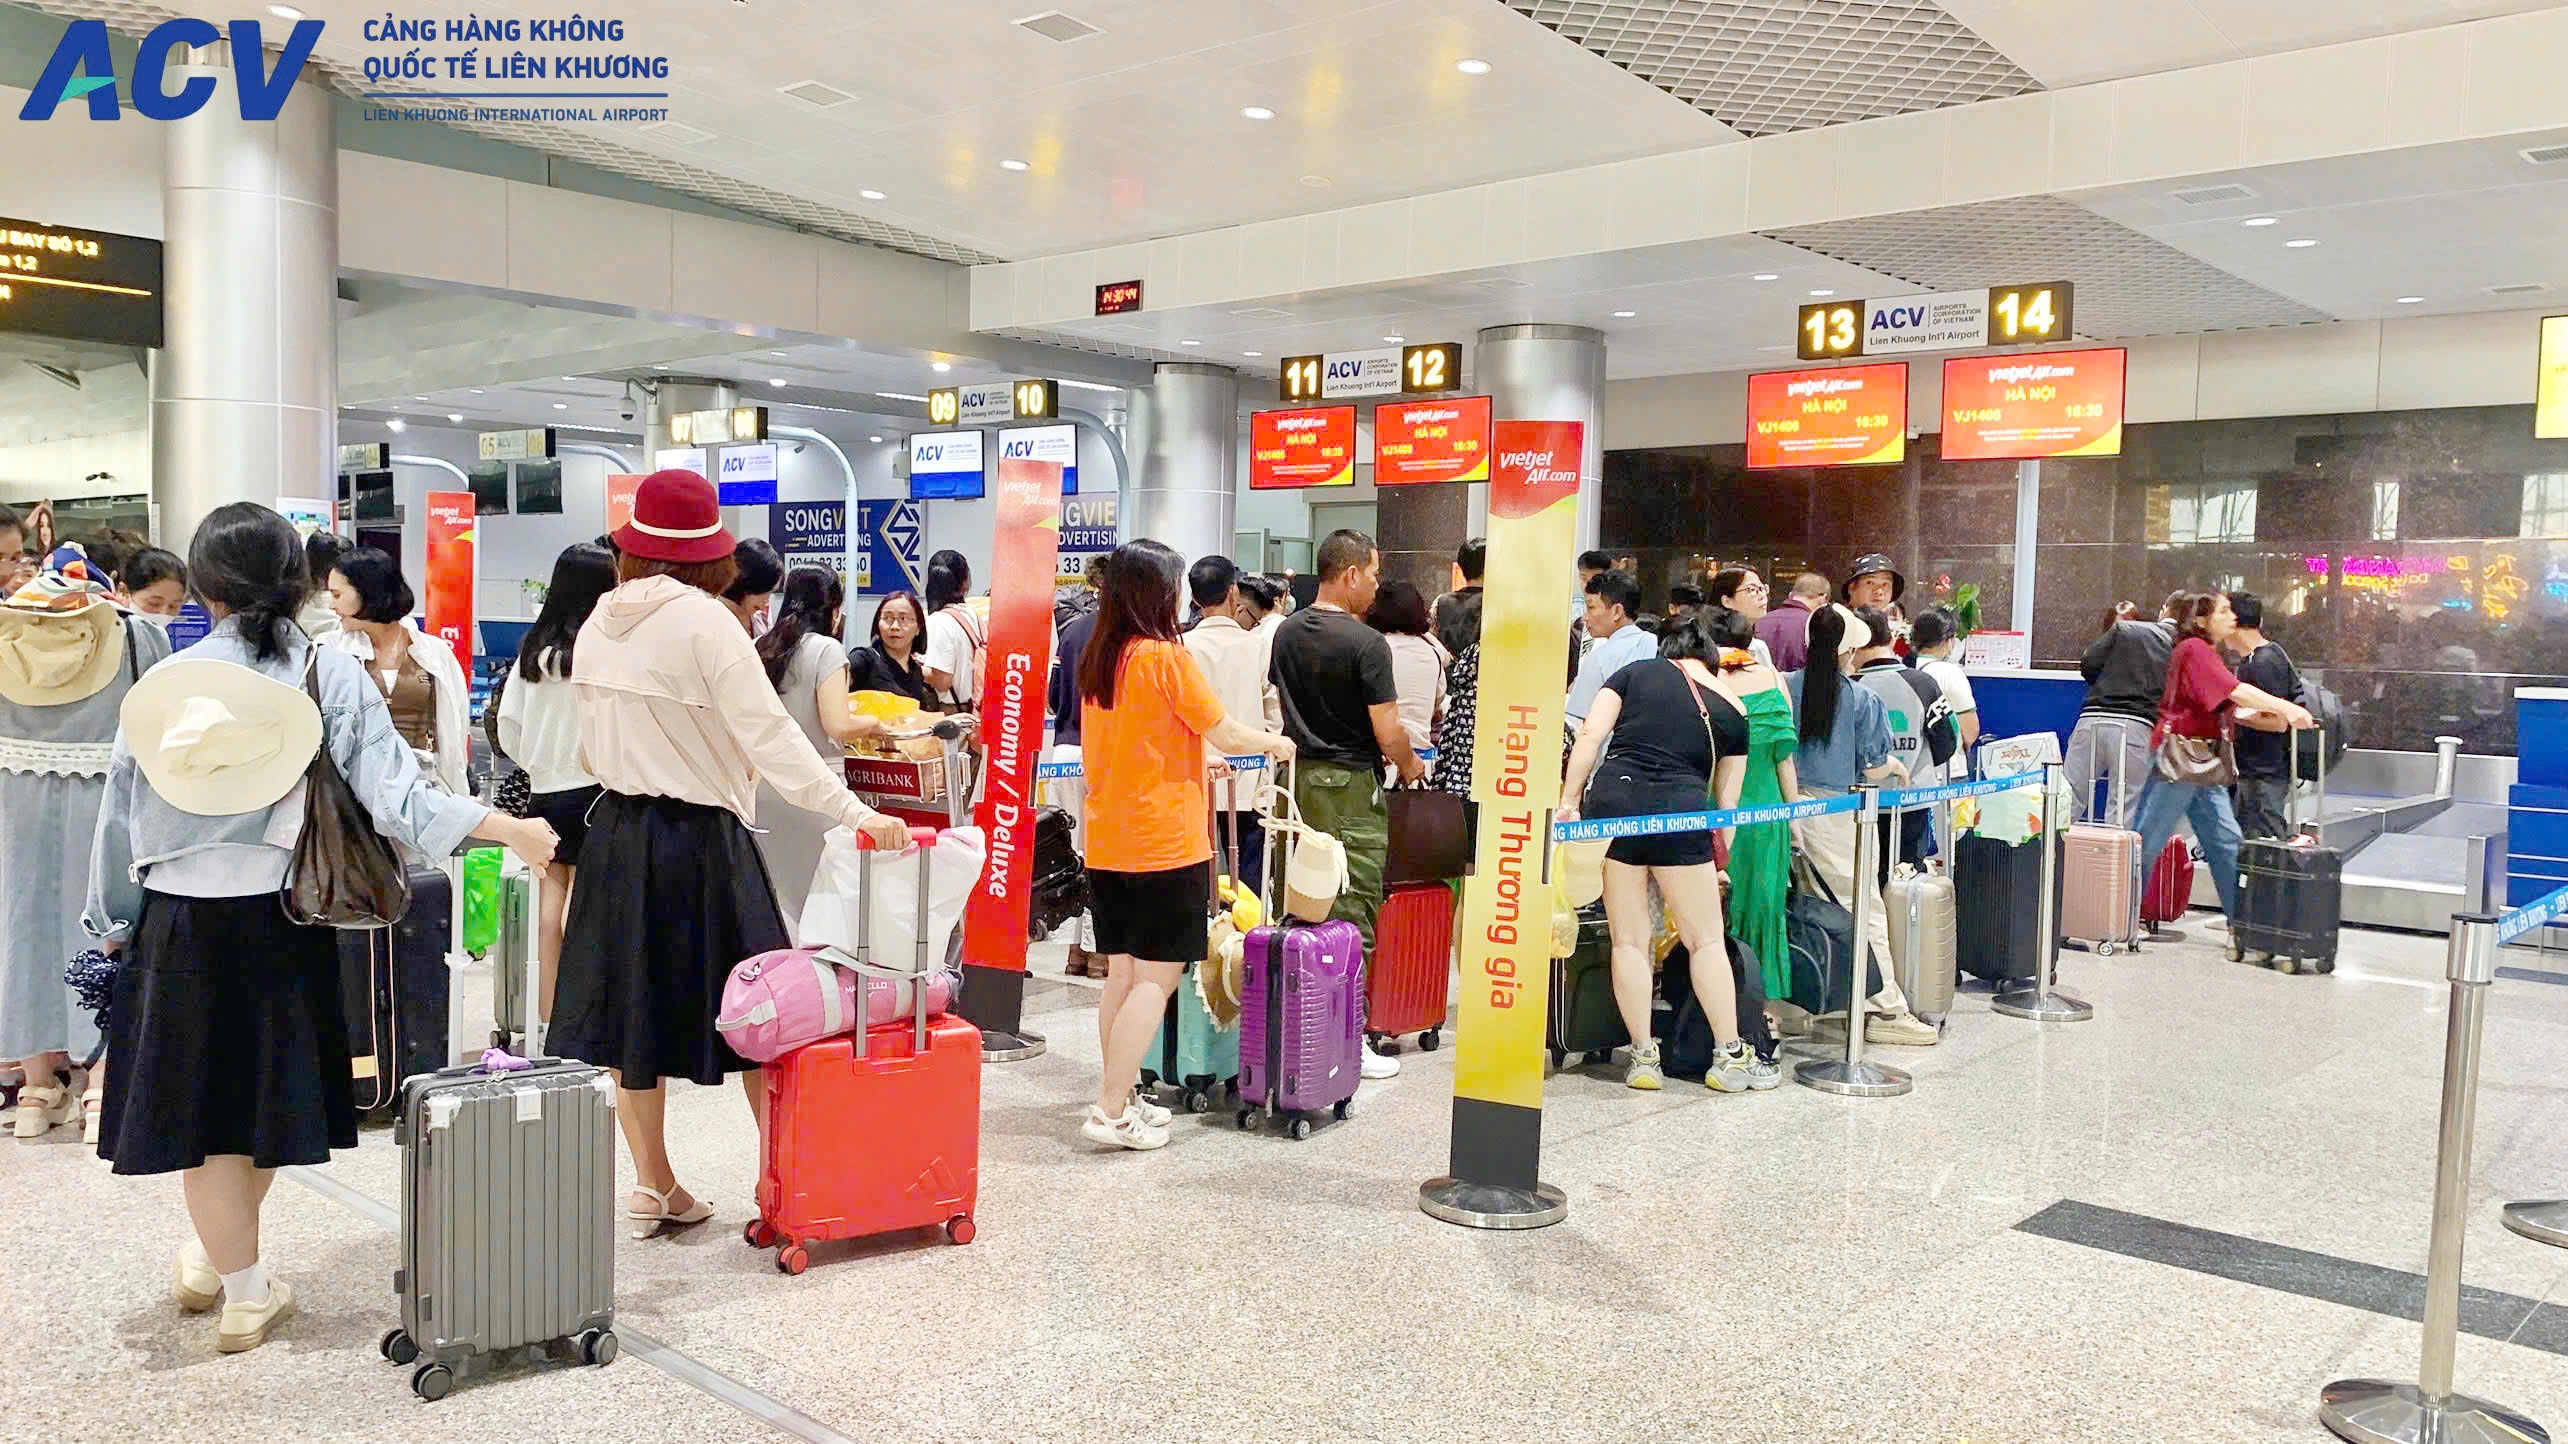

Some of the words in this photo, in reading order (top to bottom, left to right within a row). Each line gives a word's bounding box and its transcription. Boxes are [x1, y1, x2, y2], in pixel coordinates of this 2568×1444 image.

[1932, 308, 1982, 318] CORPORATION
[1933, 302, 1967, 311] AIRPORTS
[1997, 289, 2055, 336] 14
[1871, 306, 1926, 331] ACV
[1944, 315, 1975, 325] VIETNAM
[1805, 307, 1856, 352] 13
[1870, 336, 1889, 345] Lien
[1891, 334, 1926, 346] Khuong
[1947, 330, 1980, 342] Airport
[1287, 361, 1318, 396] 11
[1328, 360, 1362, 379] ACV
[1407, 349, 1445, 387] 12
[1376, 380, 1397, 389] Airport
[2005, 385, 2026, 401] HÀ
[2030, 385, 2056, 402] NỘI
[931, 392, 956, 422] 09
[962, 393, 985, 408] ACV
[1017, 384, 1044, 415] 10
[1802, 398, 1821, 414] HÀ
[1824, 398, 1847, 414] NỘI
[916, 445, 944, 462] ACV
[1005, 440, 1034, 458] ACV
[723, 457, 746, 473] ACV
[1500, 450, 1554, 471] vietjet
[1524, 468, 1577, 485] Air.com
[785, 507, 872, 532] SONGVT
[993, 652, 1031, 776] Economy
[1495, 705, 1539, 798] Hạng
[847, 769, 914, 788] AGRIBANK
[1569, 822, 1599, 840] HÀNG
[1602, 819, 1639, 837] KHÔNG
[1642, 815, 1665, 834] LIÊN
[1666, 814, 1708, 832] KHƯƠNG
[1732, 810, 1752, 826] LIEN
[1754, 807, 1791, 823] KHUONG
[1793, 801, 1828, 819] AIRPORT
[989, 803, 1019, 899] Deluxe
[1487, 811, 1532, 946] Thương
[1485, 957, 1523, 1010] gia
